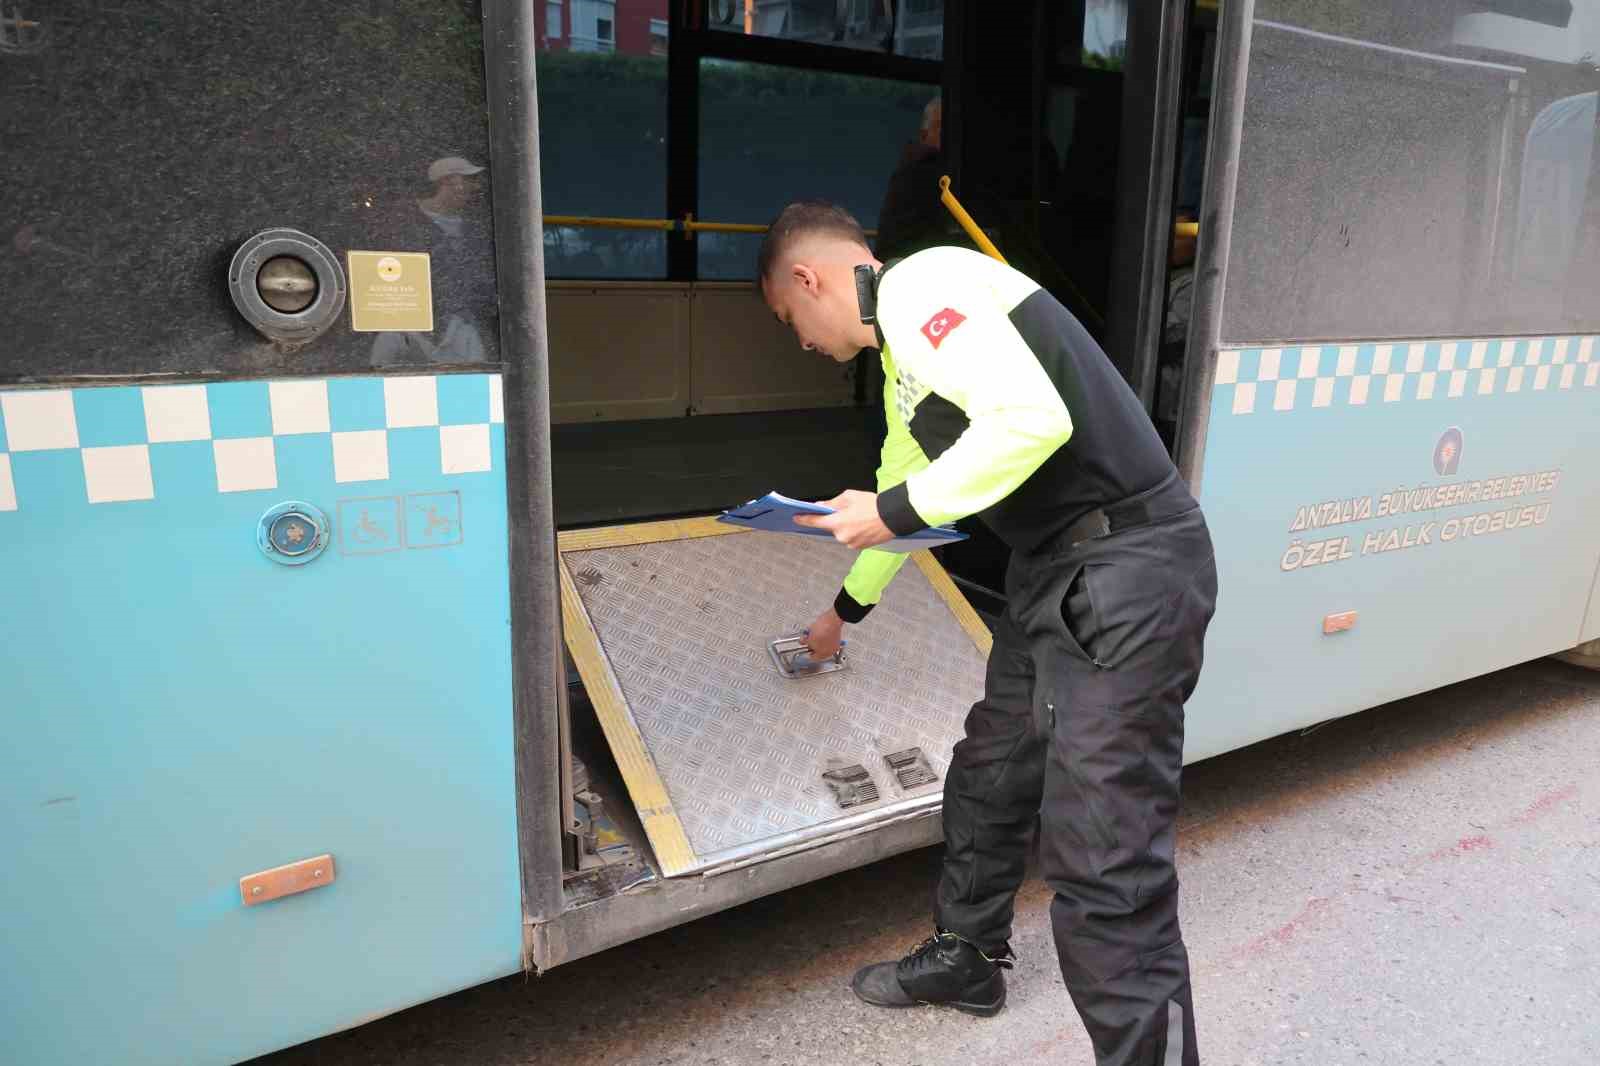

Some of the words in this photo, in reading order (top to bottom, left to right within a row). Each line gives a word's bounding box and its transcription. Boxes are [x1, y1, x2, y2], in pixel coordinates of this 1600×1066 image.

[1289, 497, 1372, 533] ANTALYA
[1281, 537, 1353, 572] ÖZEL
[1361, 526, 1432, 557] HALK
